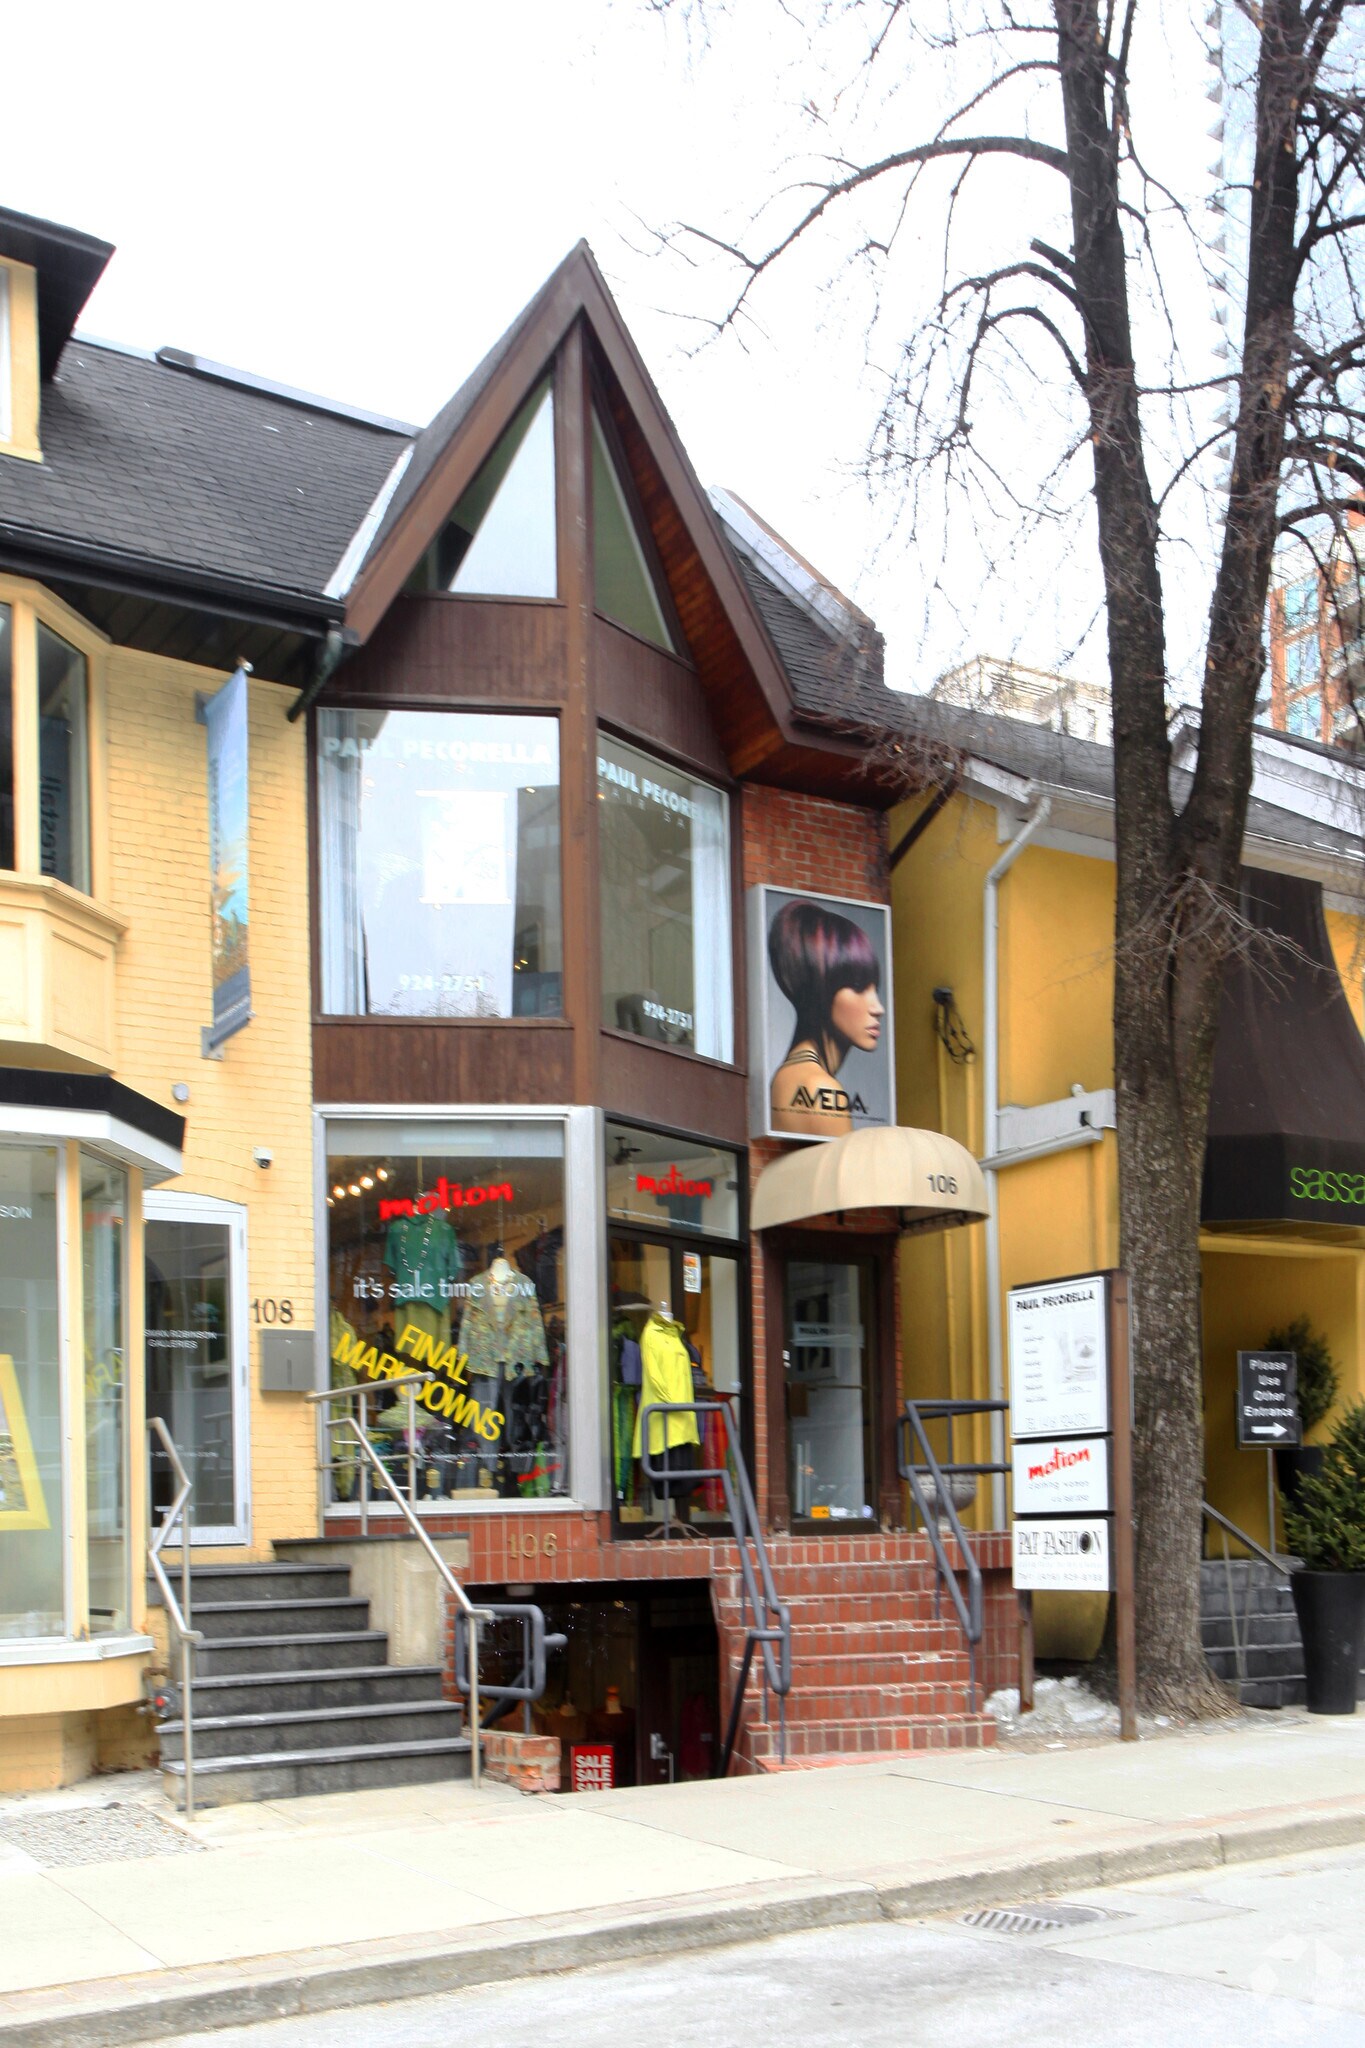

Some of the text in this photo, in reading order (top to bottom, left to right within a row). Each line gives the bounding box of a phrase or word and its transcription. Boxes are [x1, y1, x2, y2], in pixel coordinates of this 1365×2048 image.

[402, 740, 554, 765] PECORELLA
[597, 756, 640, 794] PAUL
[790, 1084, 869, 1115] AVEDA
[636, 1164, 712, 1200] motion
[926, 1174, 959, 1196] 106
[378, 1175, 513, 1222] motion
[352, 1269, 537, 1299] it's sale time now
[250, 1298, 293, 1324] 108
[396, 1323, 469, 1386] FINAL
[1249, 1359, 1288, 1371] Please
[1257, 1374, 1281, 1387] Use
[1252, 1389, 1287, 1402] Other
[1243, 1405, 1295, 1417] Entrance
[1028, 1446, 1091, 1481] motion
[507, 1532, 557, 1559] 106
[576, 1755, 612, 1768] SALE
[576, 1769, 612, 1782] SALE
